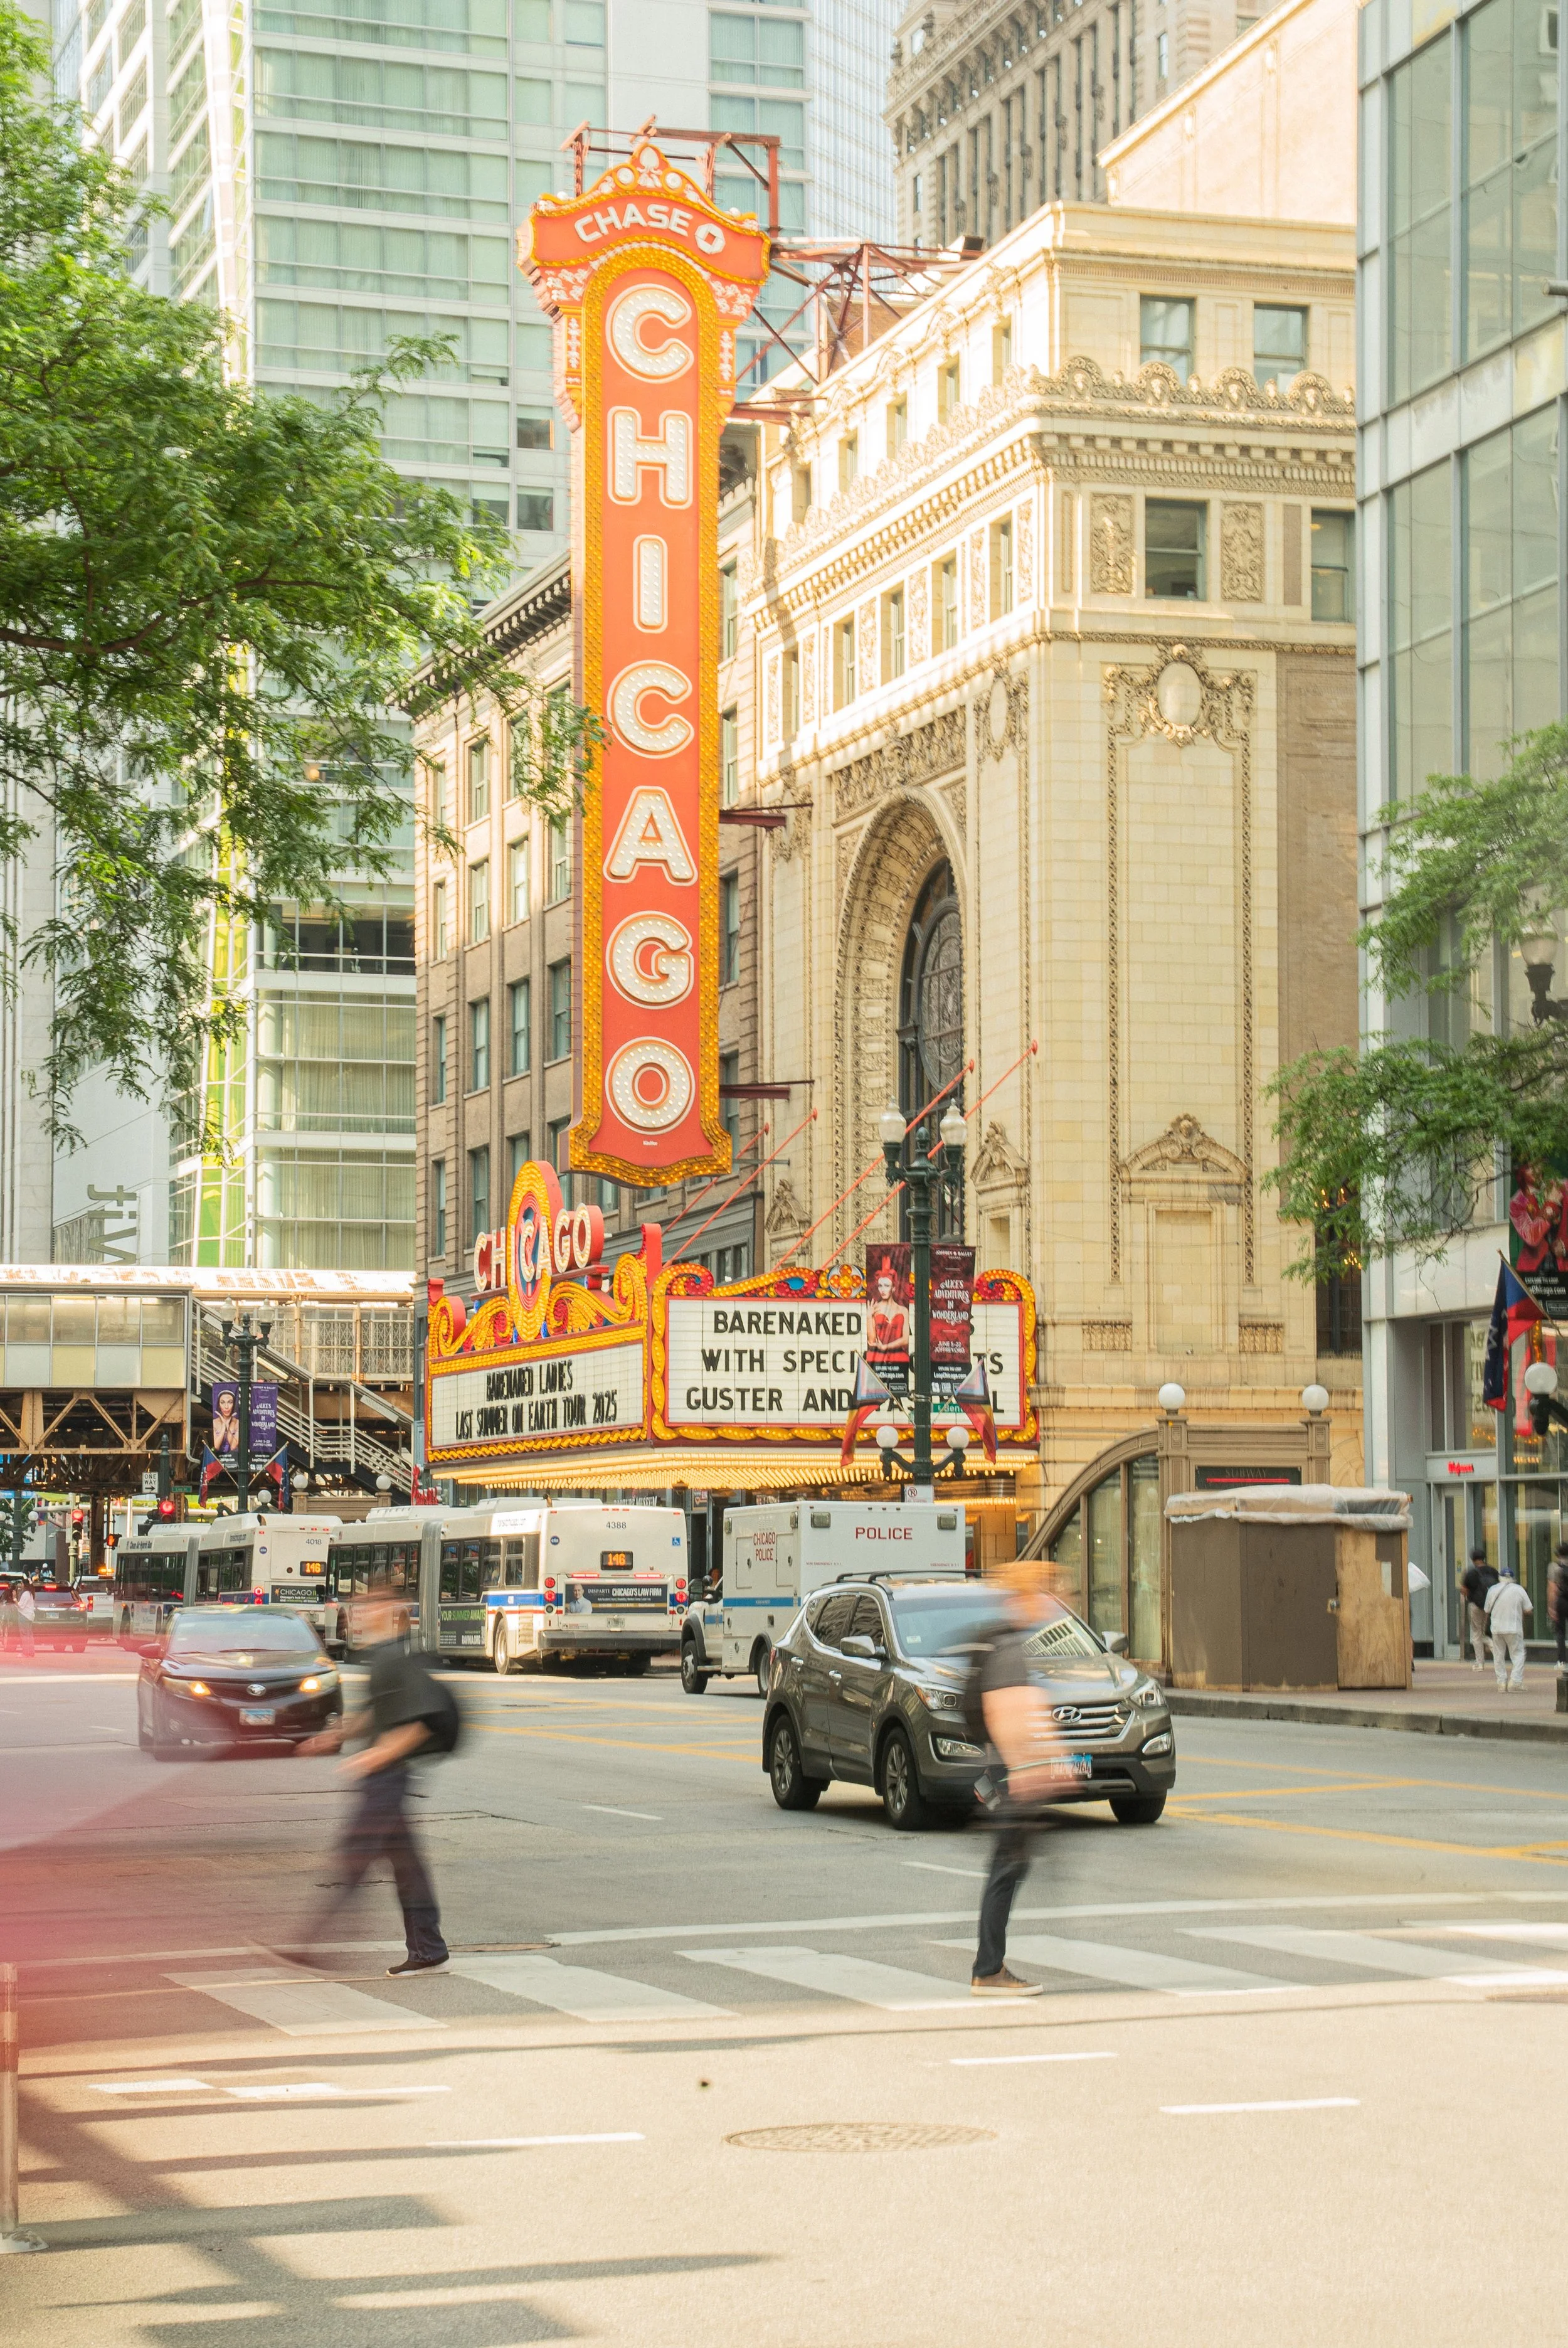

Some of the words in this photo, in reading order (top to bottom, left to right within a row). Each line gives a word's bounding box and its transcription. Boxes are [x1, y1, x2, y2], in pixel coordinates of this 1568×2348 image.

[574, 203, 693, 243] CHASE
[603, 283, 696, 1135] CHICAGO
[474, 1203, 591, 1292] CHICAGO
[940, 1279, 964, 1289] ALICE'S
[934, 1289, 970, 1304] ADVENTURES
[947, 1300, 954, 1309] IN
[714, 1310, 862, 1336] BARENAKED
[932, 1310, 969, 1324] WONDERLAND
[701, 1349, 765, 1373] WITH
[783, 1349, 867, 1373] SPECI
[539, 1359, 573, 1394] LADIES
[686, 1386, 783, 1411] GUSTER
[802, 1388, 854, 1411] AND
[455, 1410, 473, 1440] LAST
[477, 1405, 509, 1437] SUMMER
[512, 1403, 524, 1433] ON
[528, 1398, 558, 1432] EARTH
[563, 1394, 587, 1428] TOUR
[593, 1389, 617, 1424] 2025
[1226, 1468, 1268, 1478] SUBWAY
[753, 1531, 776, 1546] CHICAGO
[856, 1527, 913, 1540] POLICE
[608, 1553, 626, 1566] 146
[755, 1548, 773, 1561] POLICE
[305, 1563, 322, 1574] 146
[612, 1588, 638, 1597] CHICAGO'S
[638, 1588, 649, 1596] LAW
[649, 1588, 662, 1596] FIRM
[441, 1610, 452, 1622] YOUR
[452, 1610, 470, 1621] SUMMER
[470, 1609, 486, 1621] AWAITS
